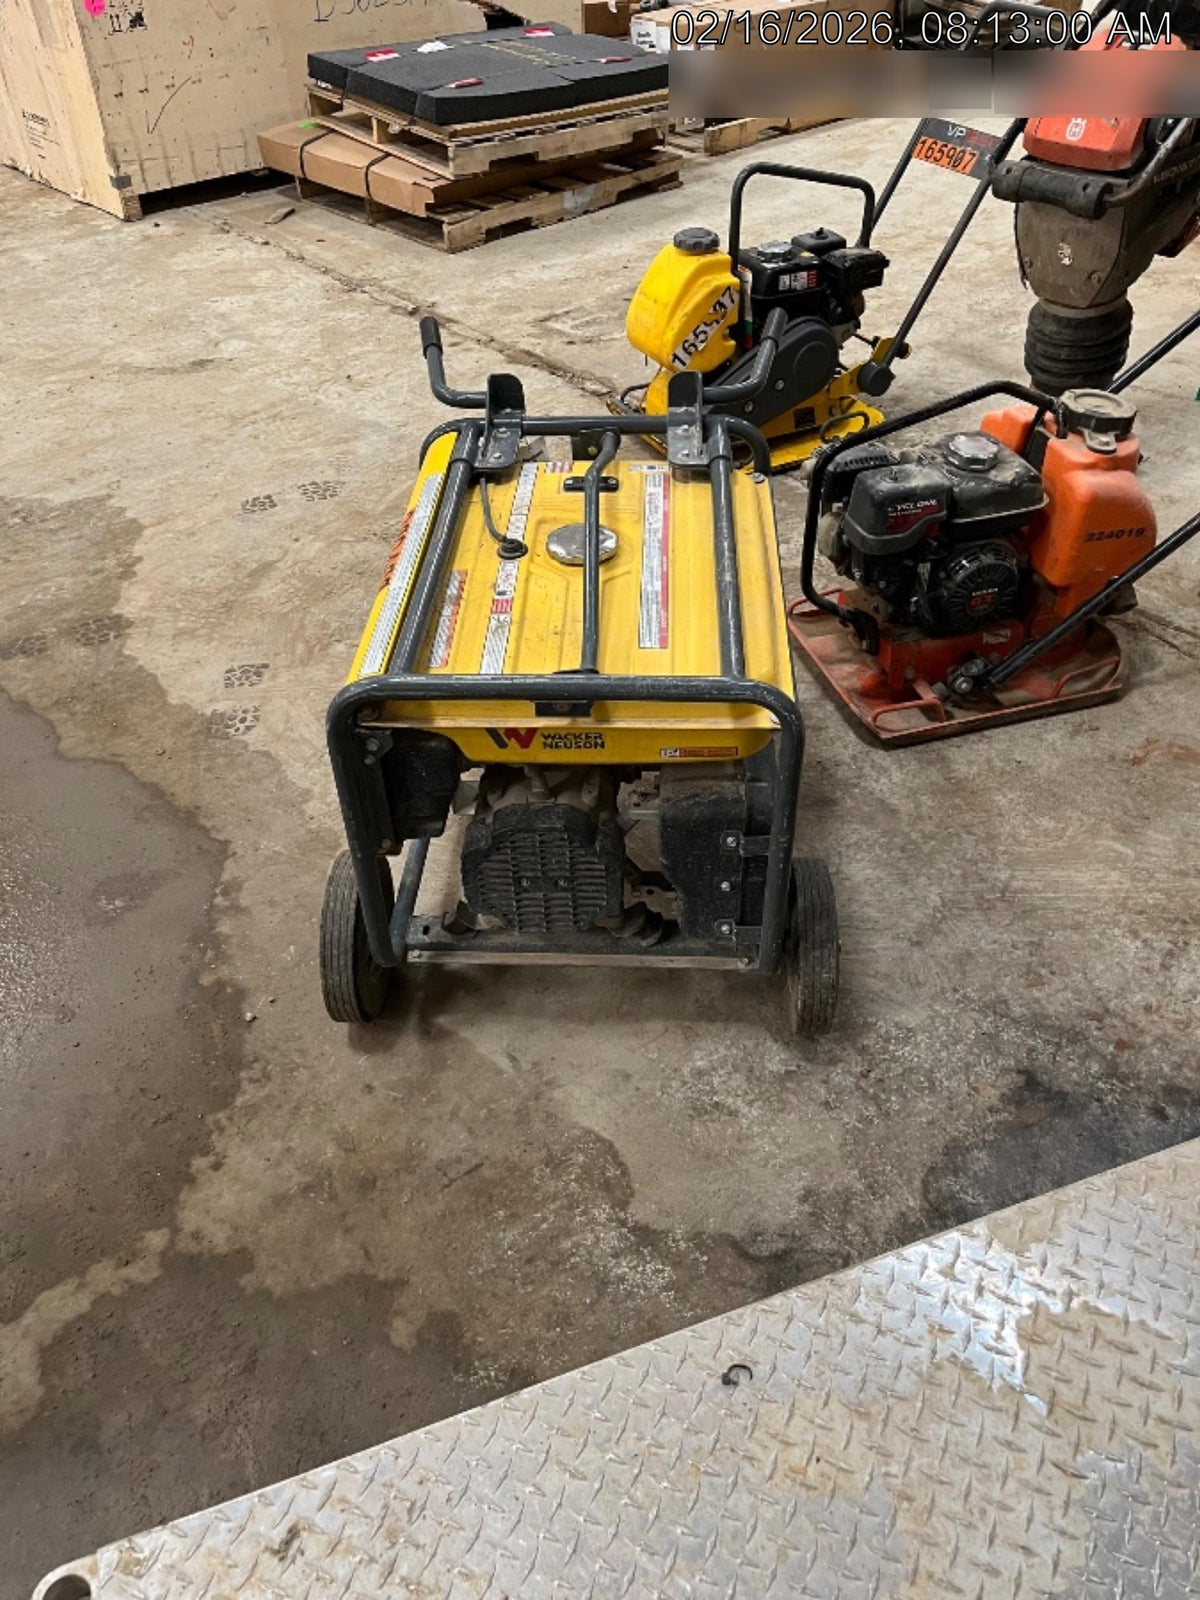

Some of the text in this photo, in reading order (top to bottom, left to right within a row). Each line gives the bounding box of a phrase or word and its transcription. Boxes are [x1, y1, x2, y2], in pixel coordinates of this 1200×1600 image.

[1083, 527, 1146, 543] 224019
[541, 731, 603, 741] WACKER
[542, 740, 606, 750] NEUSON
